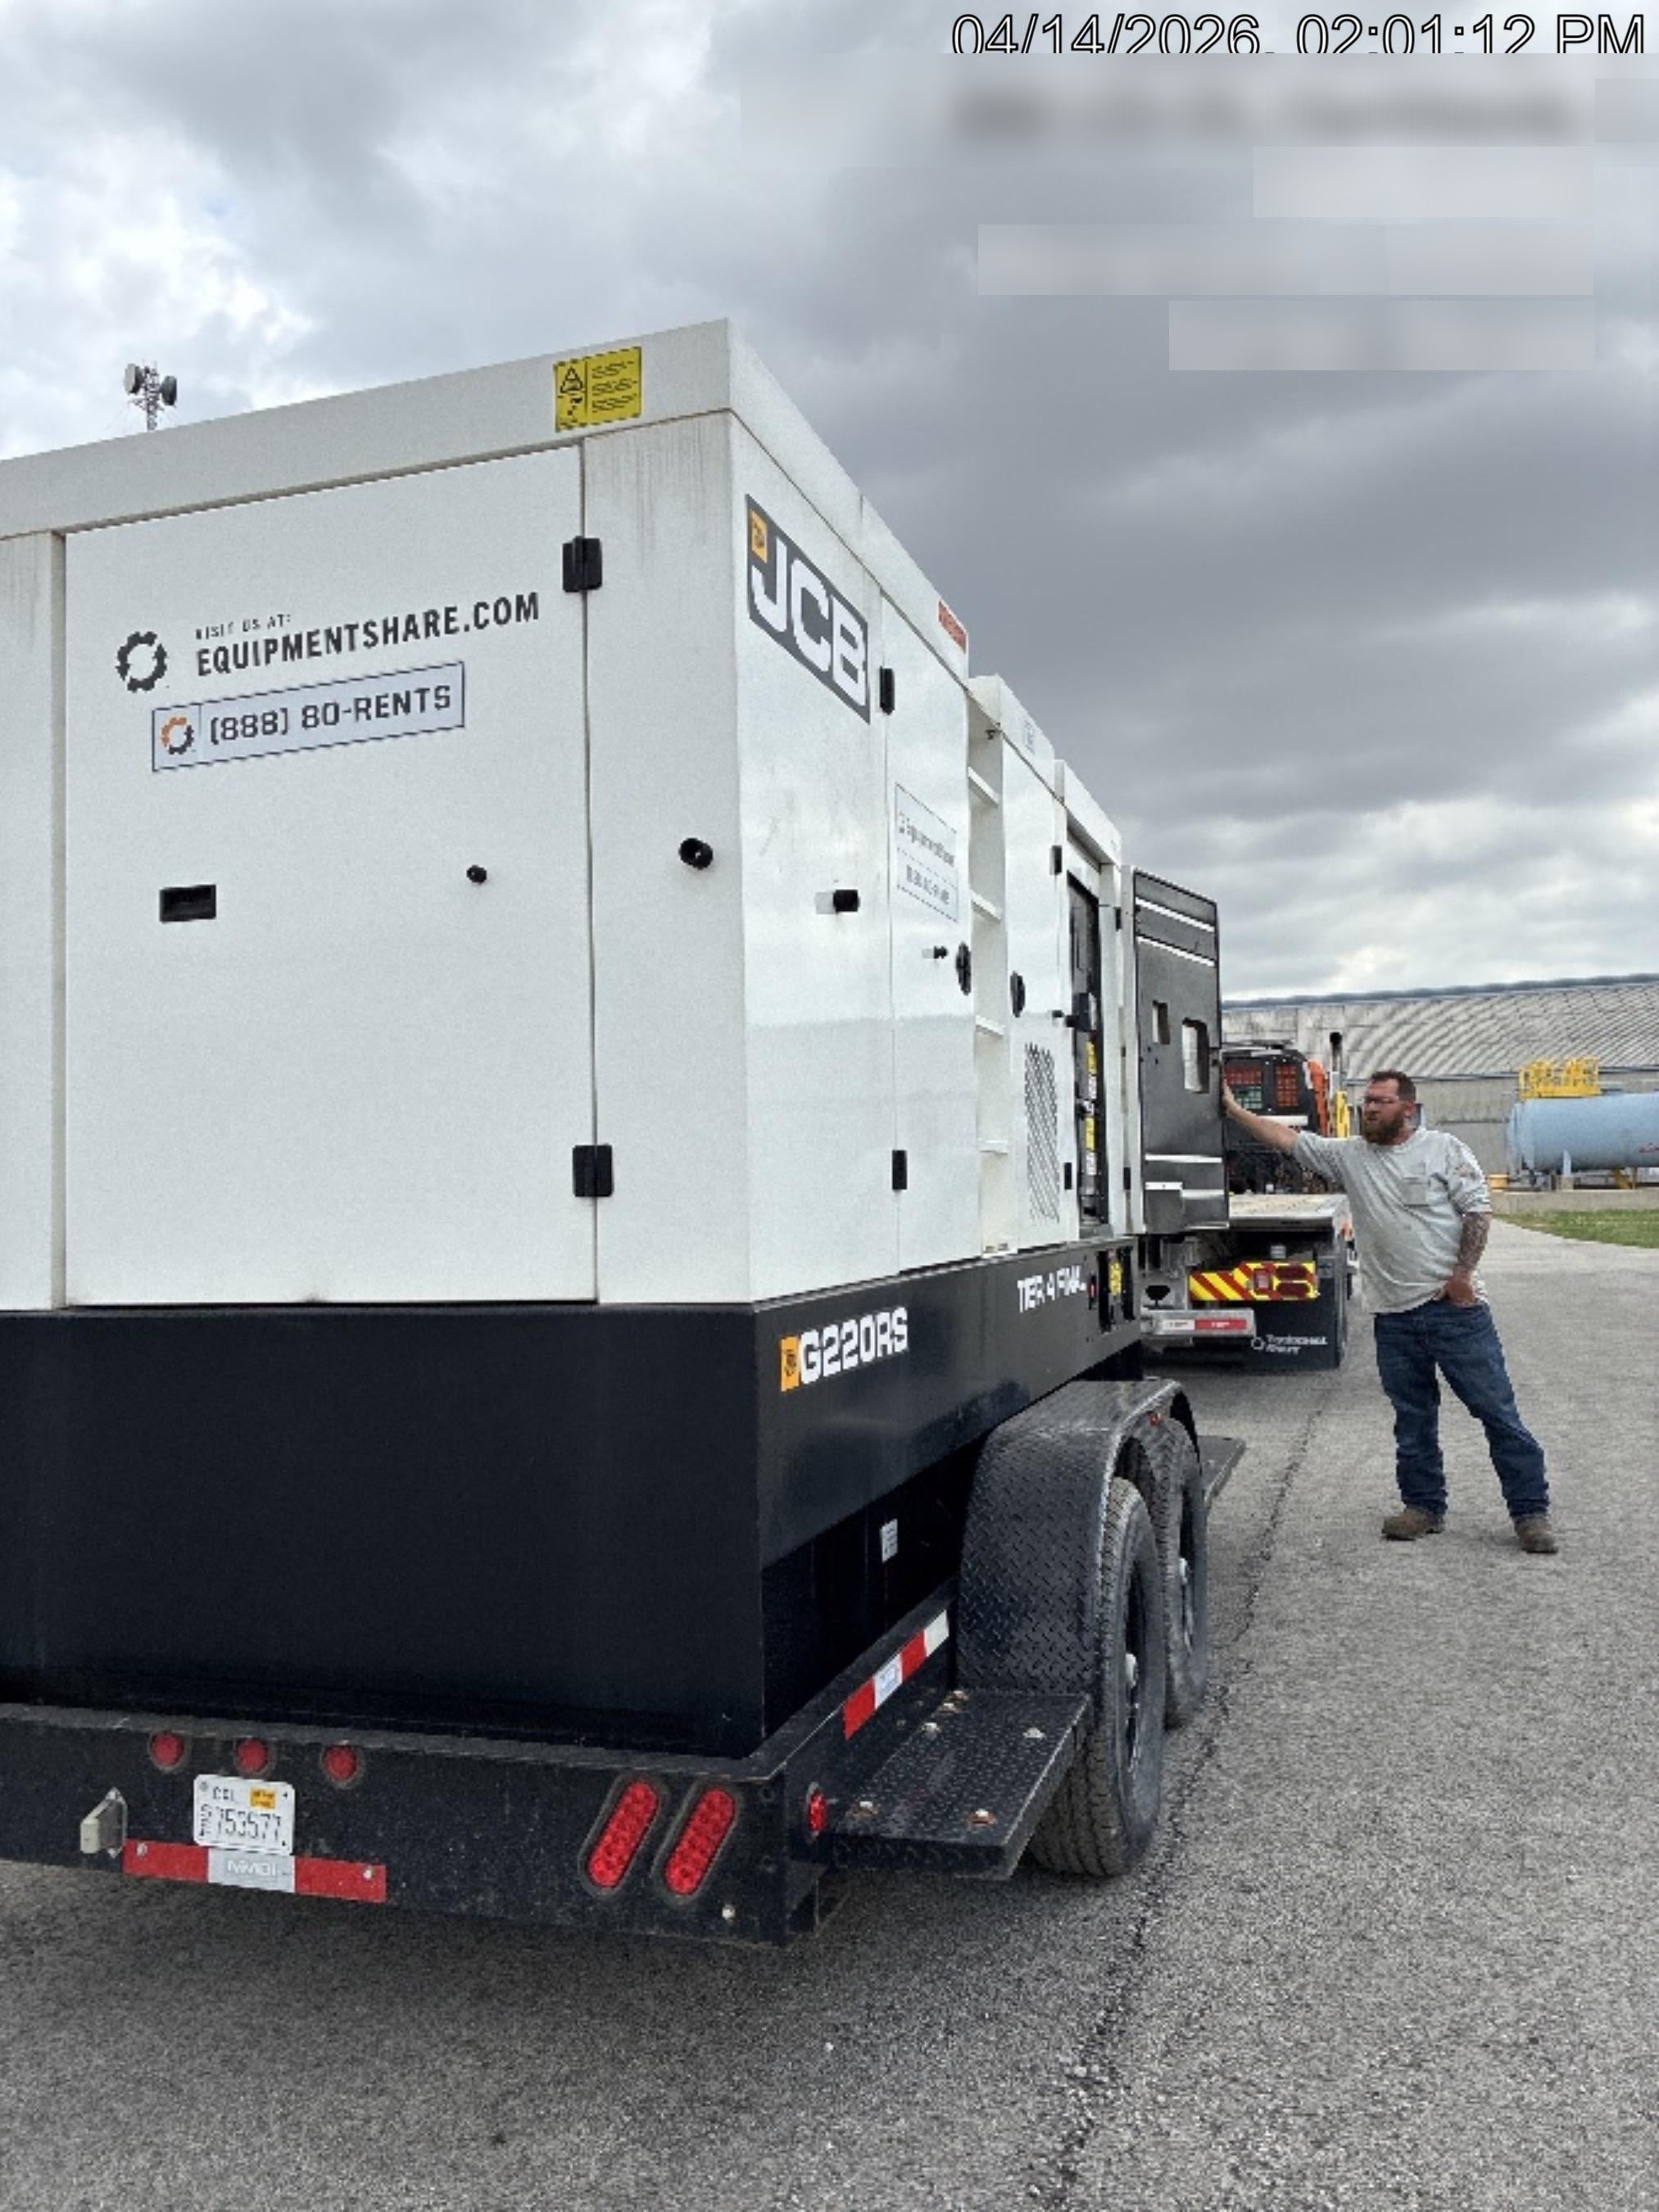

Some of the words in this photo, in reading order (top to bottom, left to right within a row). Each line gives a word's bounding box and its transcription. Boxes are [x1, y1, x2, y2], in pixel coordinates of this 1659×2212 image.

[197, 592, 539, 677] EQUIPMENTSHARE.COM
[751, 536, 867, 707] JCB
[301, 685, 451, 730] 80-RENTS
[1017, 1275, 1045, 1313] TIER
[799, 1306, 908, 1385] G220RS
